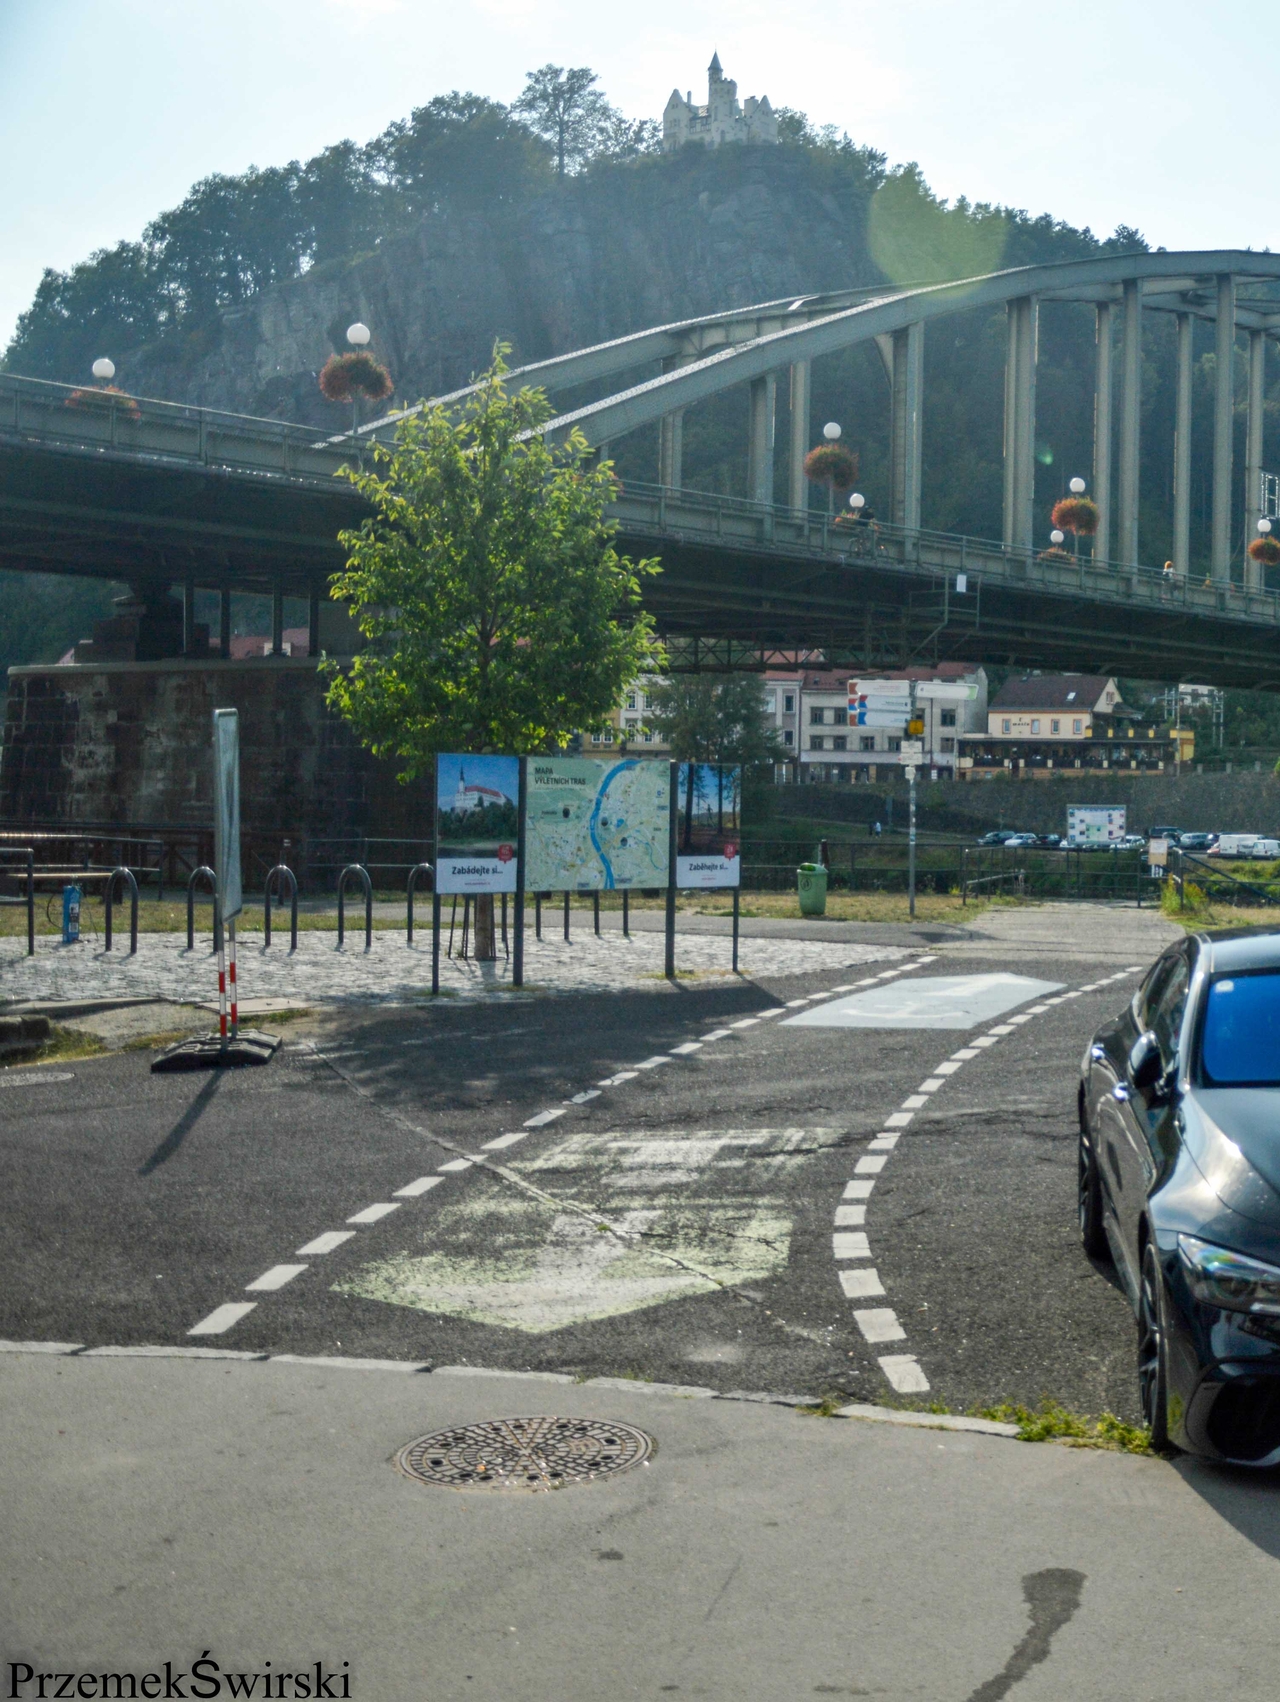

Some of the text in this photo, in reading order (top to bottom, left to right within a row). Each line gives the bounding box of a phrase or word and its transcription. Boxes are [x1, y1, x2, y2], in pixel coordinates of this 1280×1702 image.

[535, 767, 554, 775] MAPA
[535, 776, 570, 785] VÝLETNÍCH
[451, 865, 490, 876] Zabádejte
